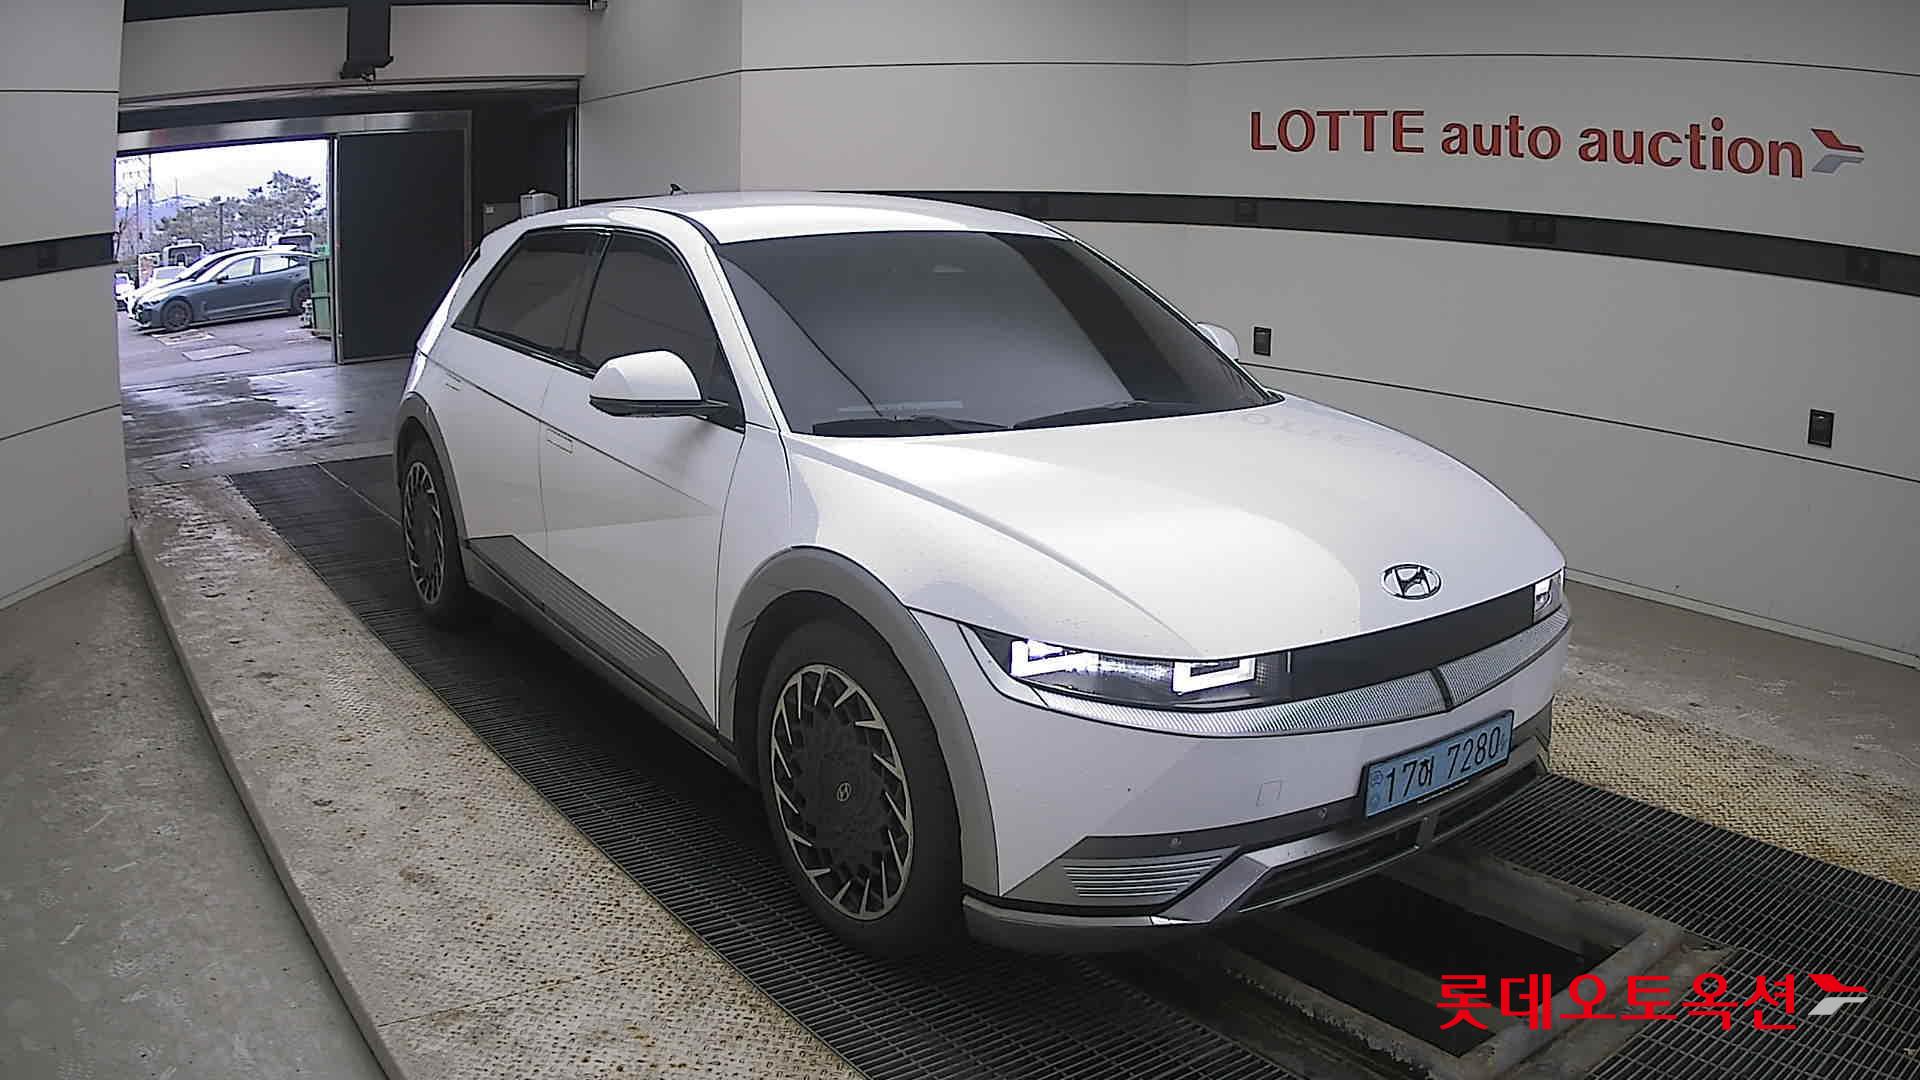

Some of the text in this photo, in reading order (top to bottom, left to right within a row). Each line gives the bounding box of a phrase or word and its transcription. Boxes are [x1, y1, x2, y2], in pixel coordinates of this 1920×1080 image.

[1249, 109, 1805, 180] LOTTE auto auction
[1447, 726, 1501, 780] 7280
